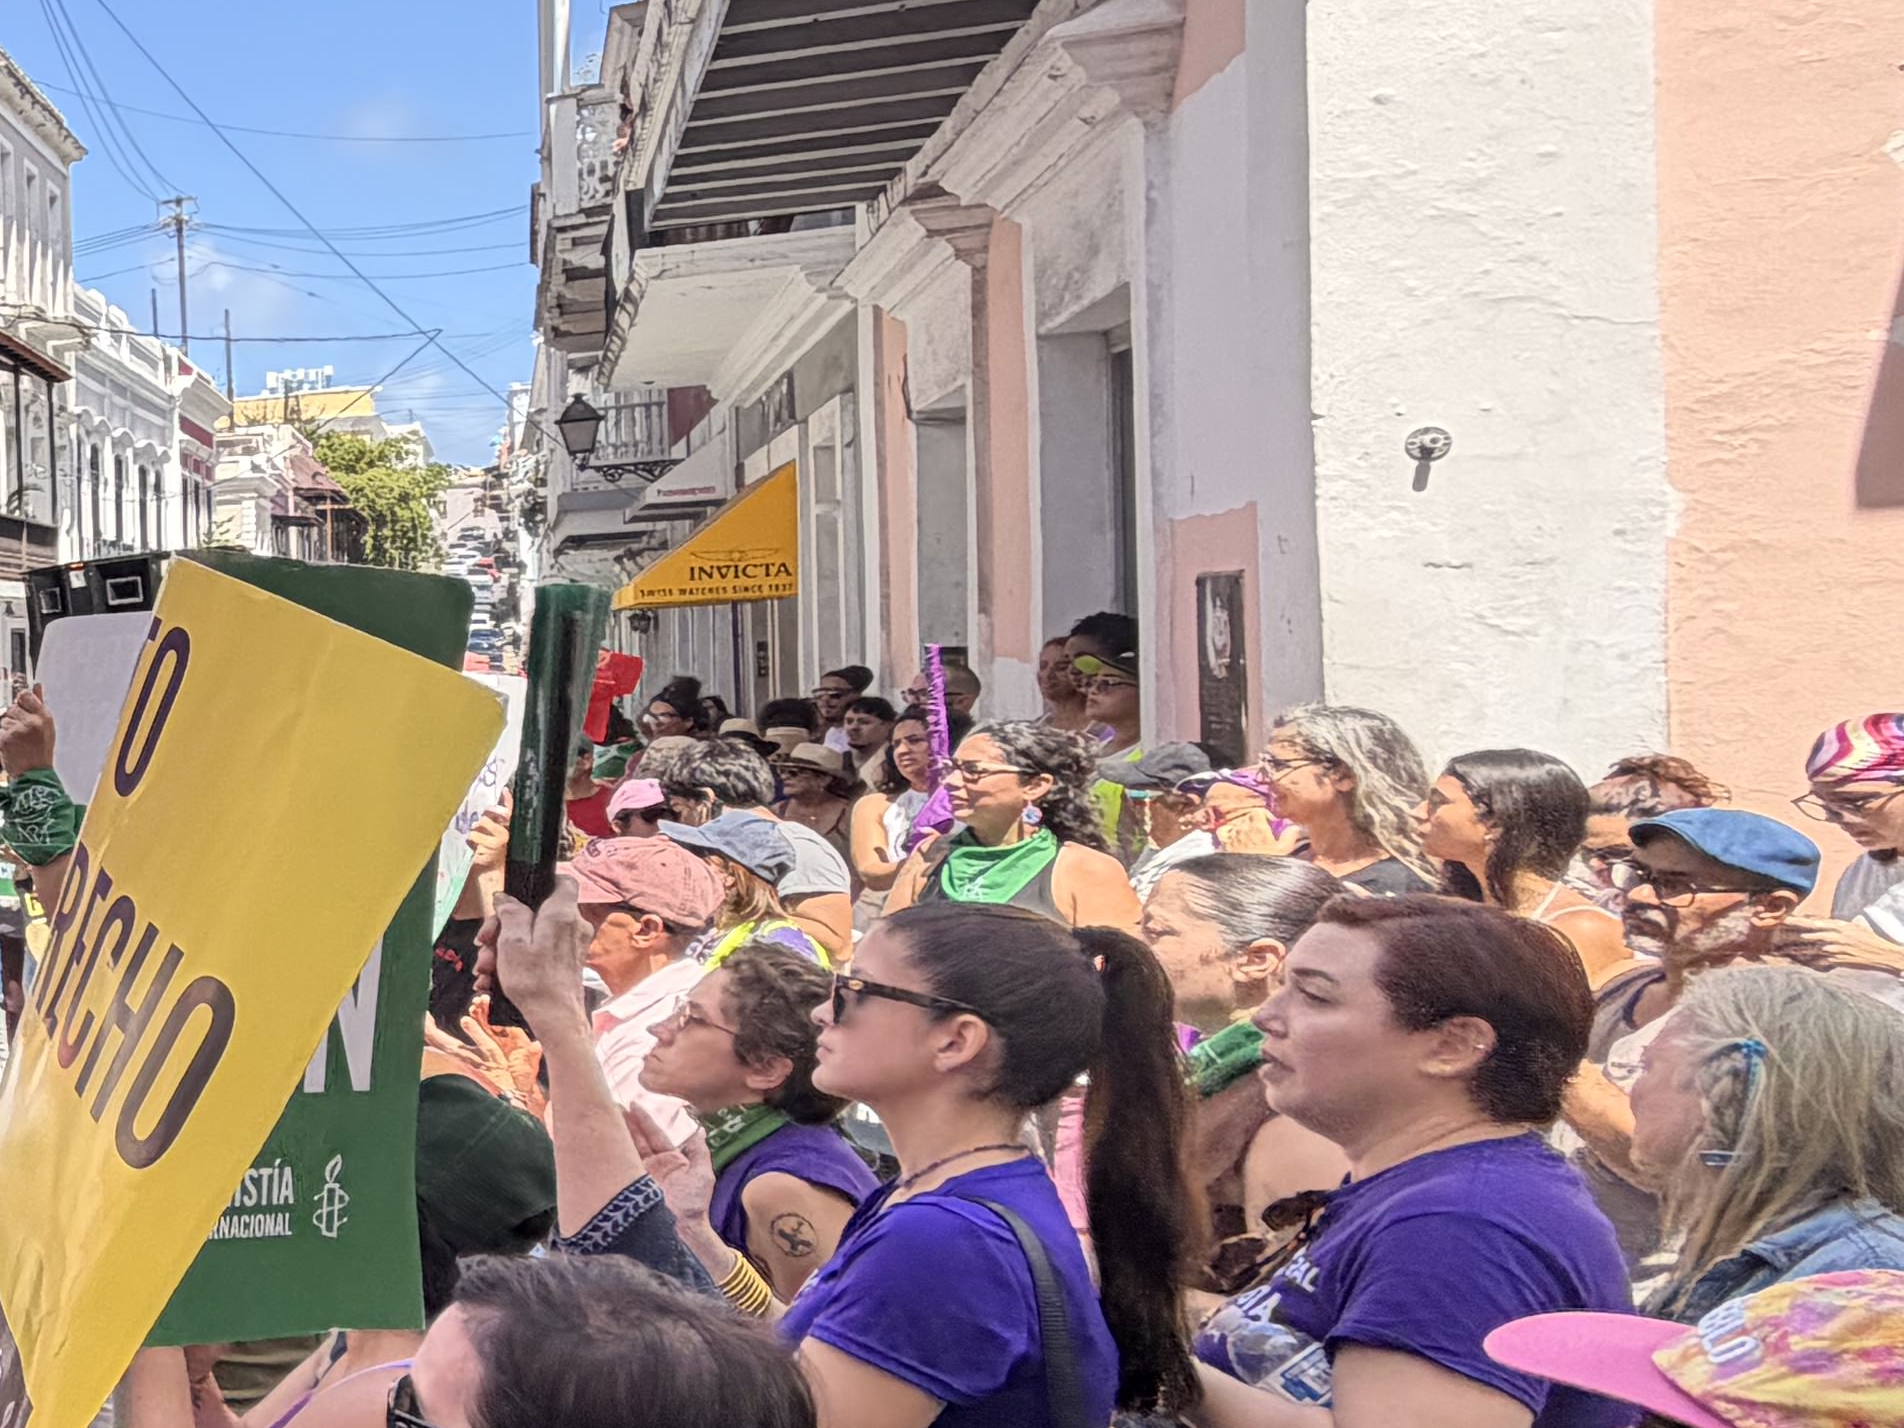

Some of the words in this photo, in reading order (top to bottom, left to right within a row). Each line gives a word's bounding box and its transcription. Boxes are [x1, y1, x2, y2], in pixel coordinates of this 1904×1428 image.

[689, 562, 793, 581] INVICTA
[678, 585, 728, 596] WATCHES
[732, 584, 763, 595] SINCE
[114, 617, 191, 798] O
[226, 1158, 295, 1209] ISTÍA
